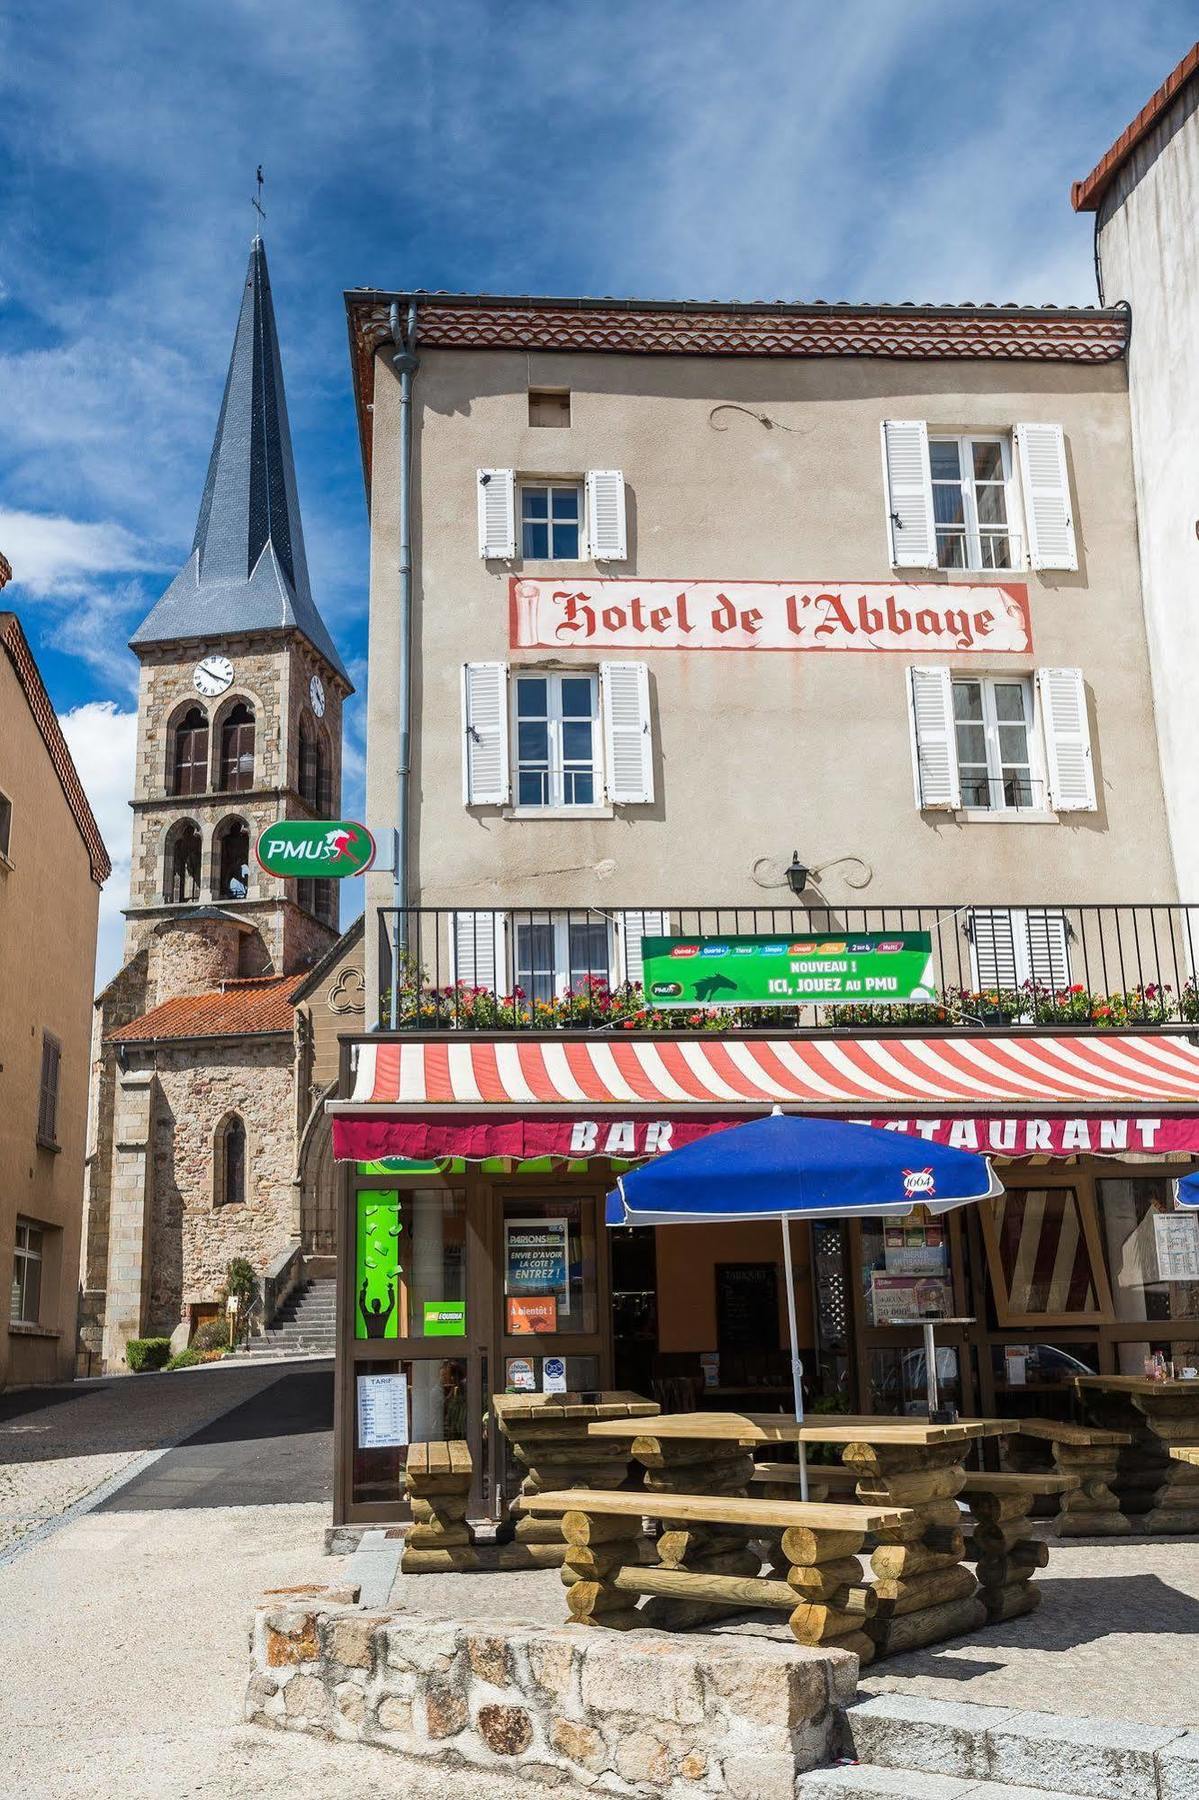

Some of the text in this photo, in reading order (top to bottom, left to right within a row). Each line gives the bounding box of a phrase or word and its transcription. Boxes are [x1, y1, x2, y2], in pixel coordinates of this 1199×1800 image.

[552, 591, 996, 648] Hotel de l'Abbaye
[267, 840, 323, 859] PMU
[790, 960, 848, 973] NOUVEAU
[768, 978, 793, 995] ICI,
[796, 978, 842, 992] JOUEZ
[865, 977, 898, 991] PMU
[569, 1120, 673, 1152] BAR
[906, 1176, 931, 1188] 1664
[510, 1235, 547, 1244] PARIONS
[511, 1251, 563, 1259] ENVIE D'AVOIR
[515, 1269, 554, 1279] ENTREZ
[518, 1306, 547, 1315] bientôt
